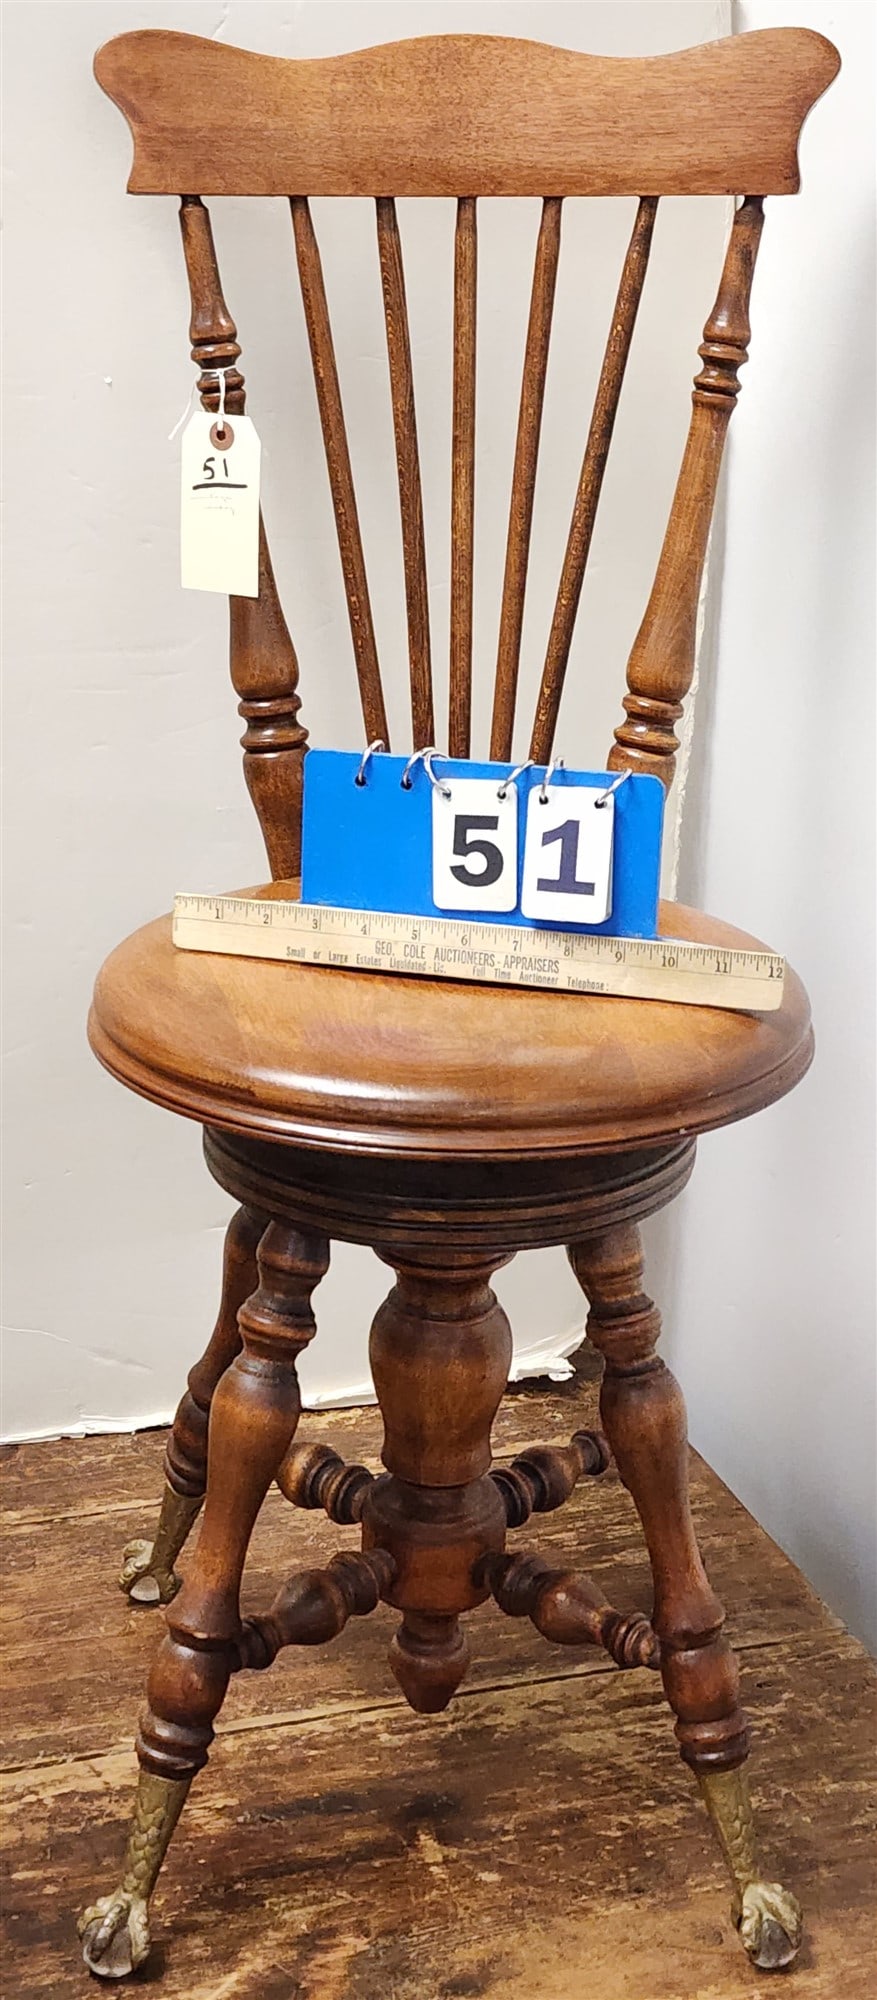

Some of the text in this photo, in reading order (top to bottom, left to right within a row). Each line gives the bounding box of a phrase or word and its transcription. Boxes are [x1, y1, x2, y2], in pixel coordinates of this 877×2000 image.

[203, 456, 229, 480] 51
[214, 907, 784, 979] 1 2 3 4 5 6 7 8 9 10 11 12
[374, 940, 396, 957] GEO.
[403, 944, 427, 960] COLE
[286, 945, 306, 959] Small
[313, 950, 322, 960] or
[328, 950, 349, 964] Large
[356, 953, 382, 967] Estates
[472, 965, 486, 977] Full
[494, 967, 512, 981] Time
[518, 971, 559, 986] Auctioneer
